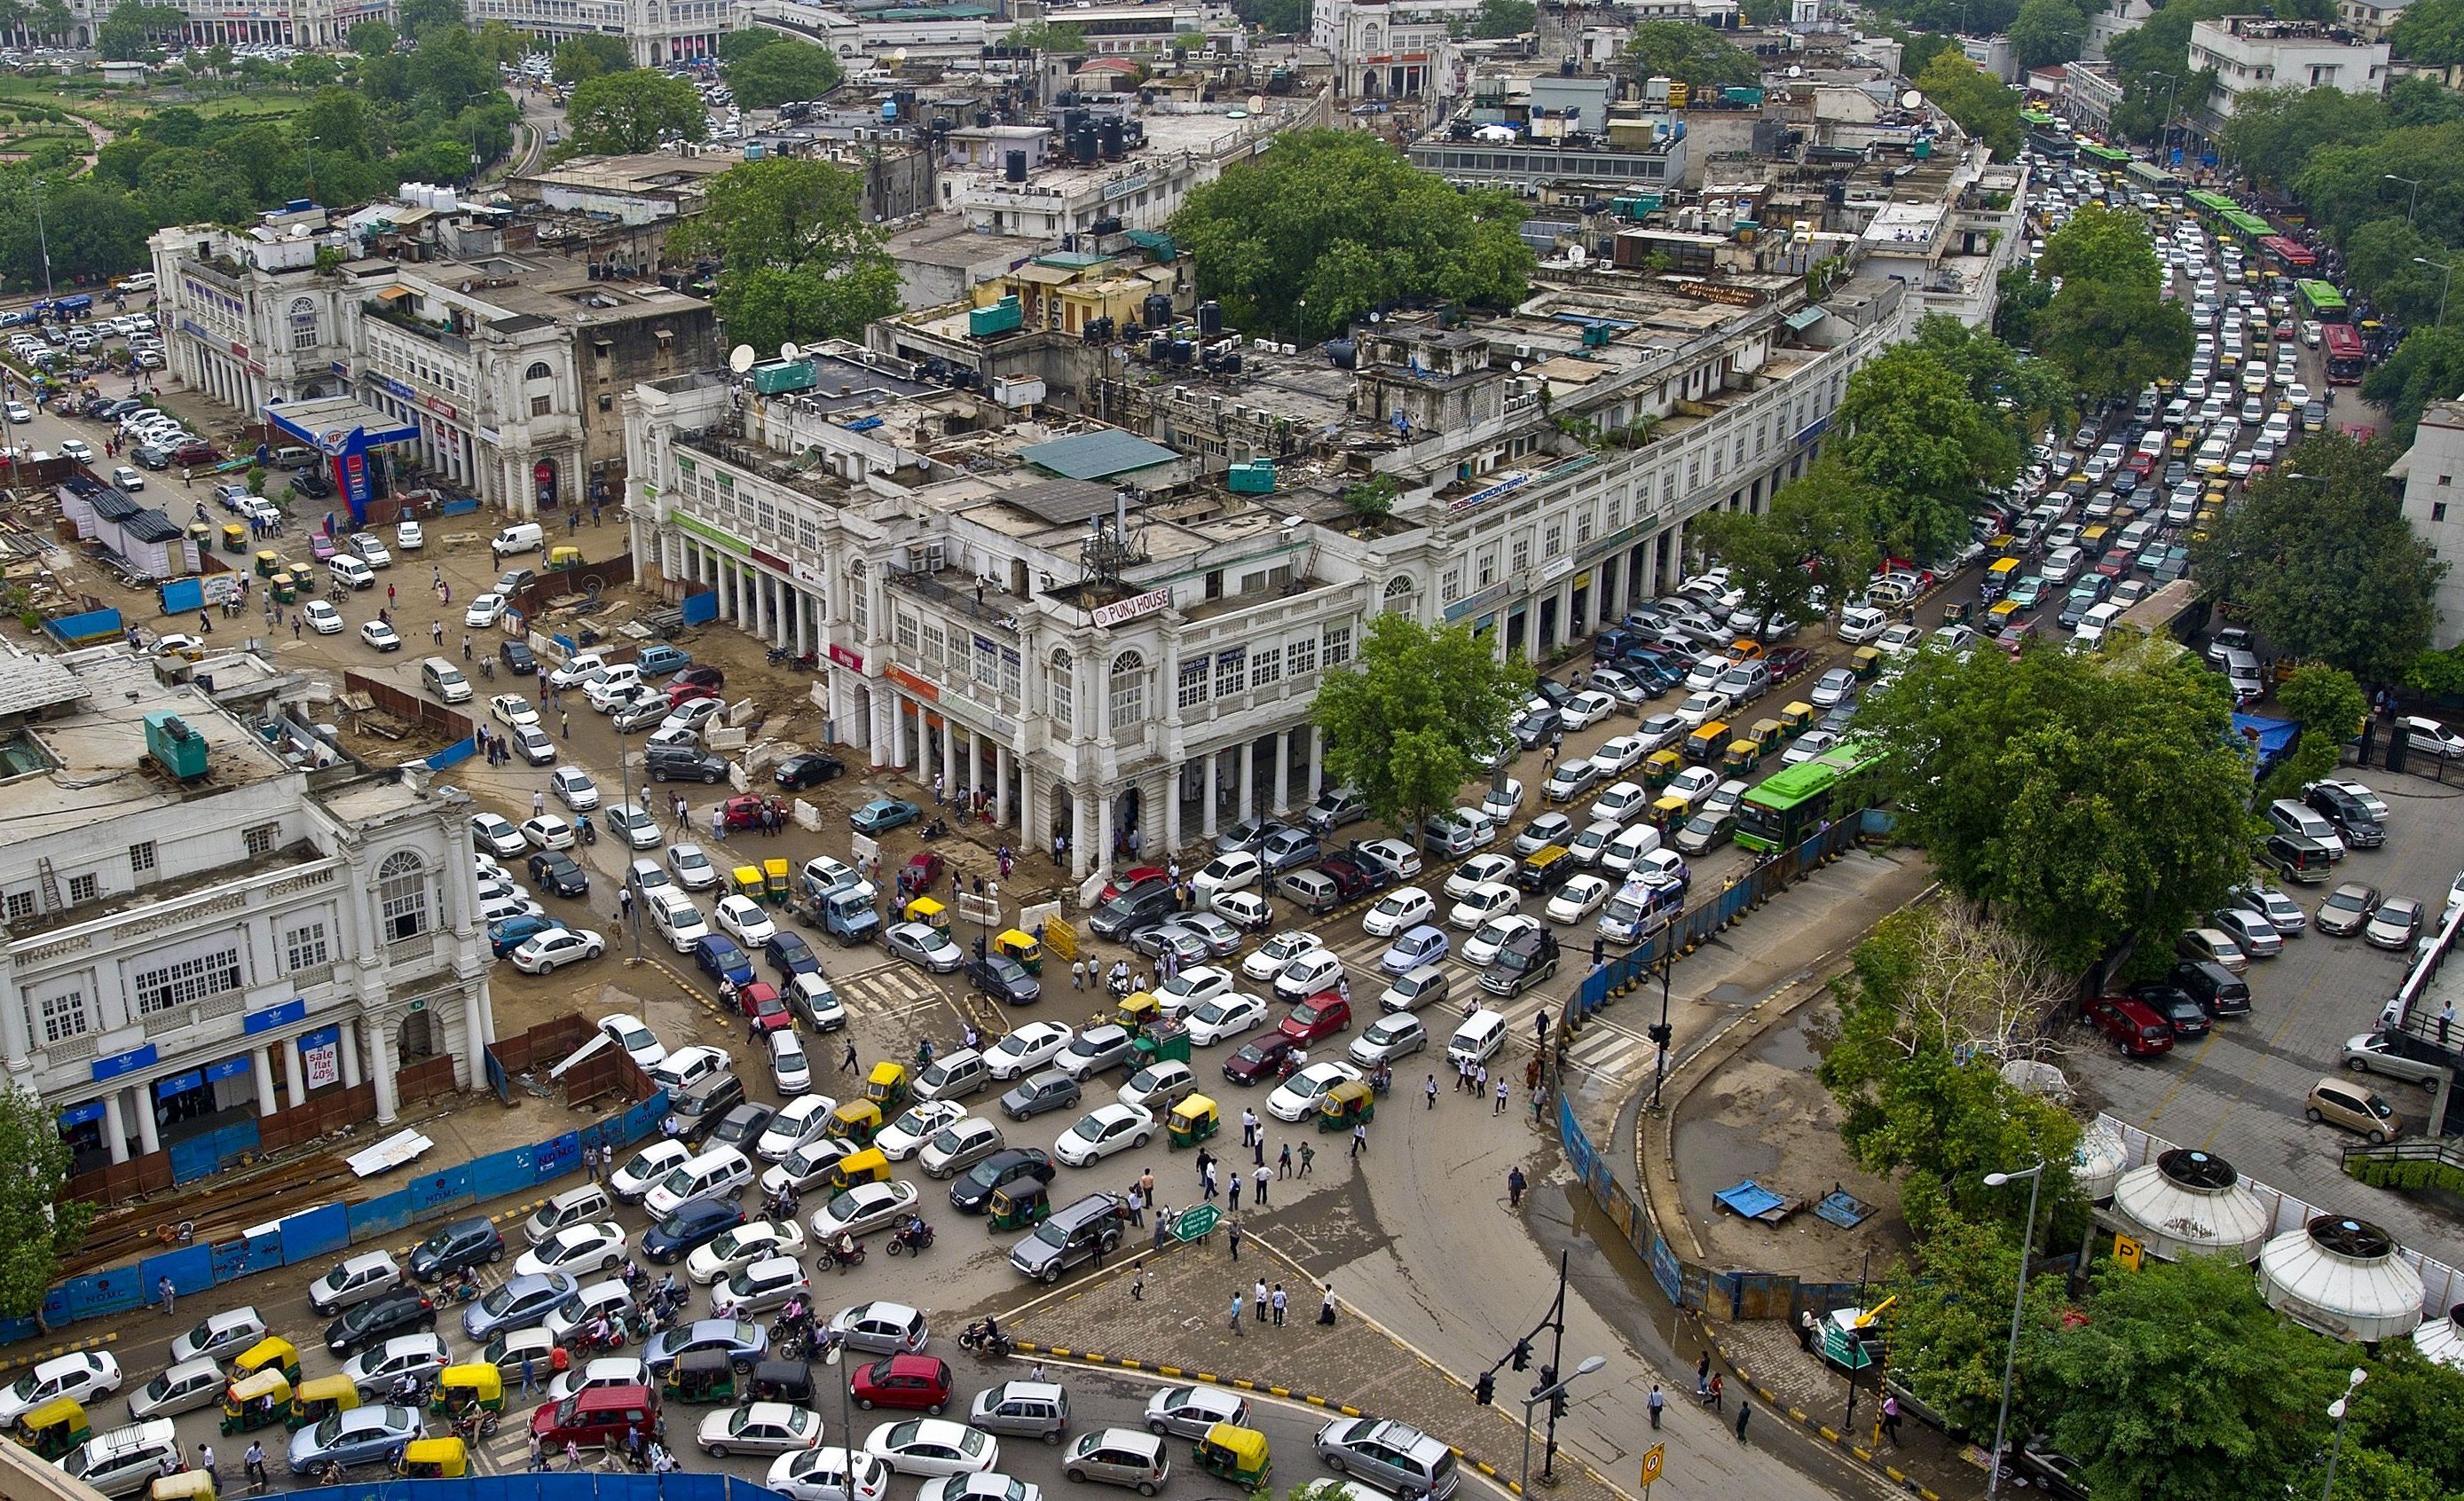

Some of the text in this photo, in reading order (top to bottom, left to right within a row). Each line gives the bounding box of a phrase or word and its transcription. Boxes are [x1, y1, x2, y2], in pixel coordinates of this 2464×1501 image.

[1106, 182, 1126, 198] HARSHA
[433, 401, 452, 416] LIBERTY
[327, 433, 342, 444] HP
[1108, 590, 1168, 621] PUNJ HOUSE
[309, 1049, 334, 1062] sale
[314, 1060, 331, 1070] flat
[312, 1068, 335, 1080] 40%
[2119, 1244, 2134, 1256] P
